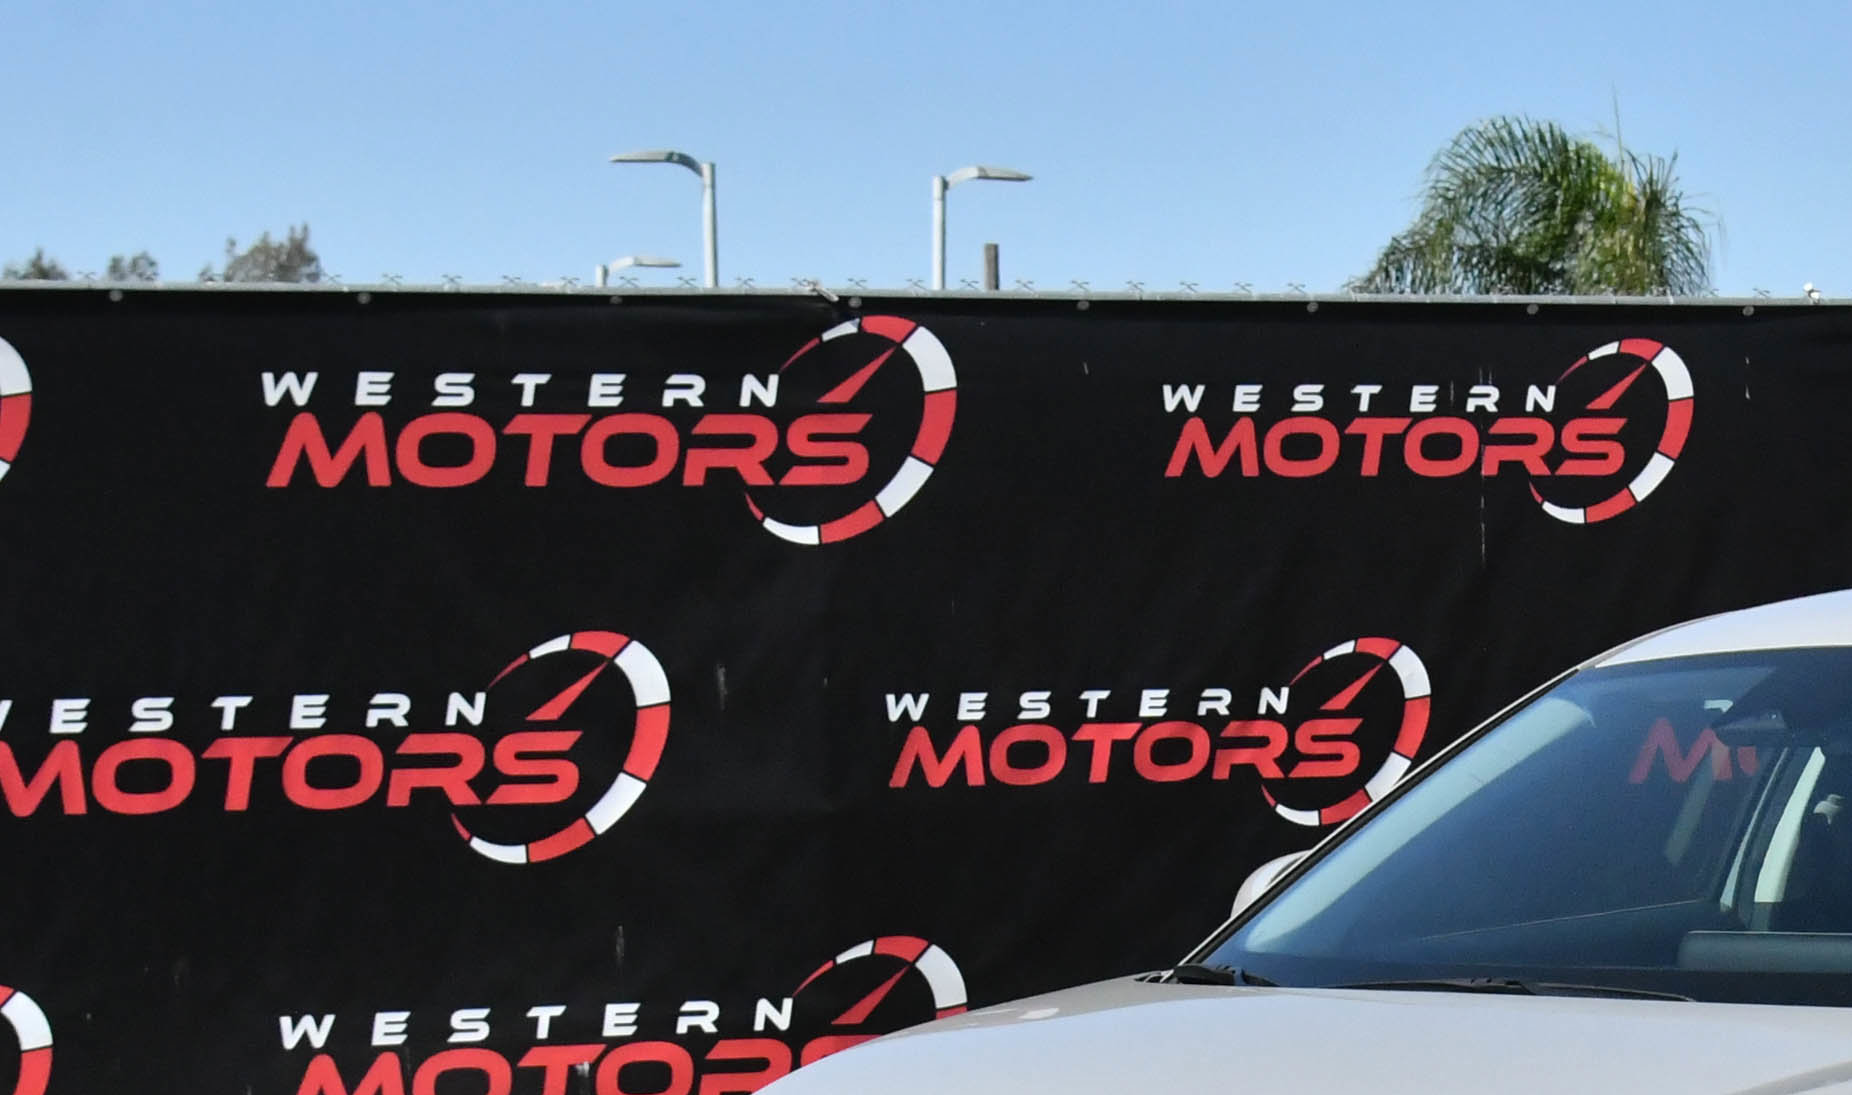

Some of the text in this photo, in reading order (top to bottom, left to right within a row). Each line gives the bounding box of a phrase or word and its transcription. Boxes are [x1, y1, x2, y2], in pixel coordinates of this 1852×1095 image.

[262, 371, 779, 407] WESTERN
[1163, 384, 1557, 412] WESTERN
[266, 411, 873, 487] MOTORS
[1164, 416, 1627, 477] MOTORS
[886, 686, 1290, 721] WESTERN
[0, 730, 583, 818] MOTORS
[889, 717, 1363, 788] MOTORS
[279, 997, 794, 1051] WESTERN
